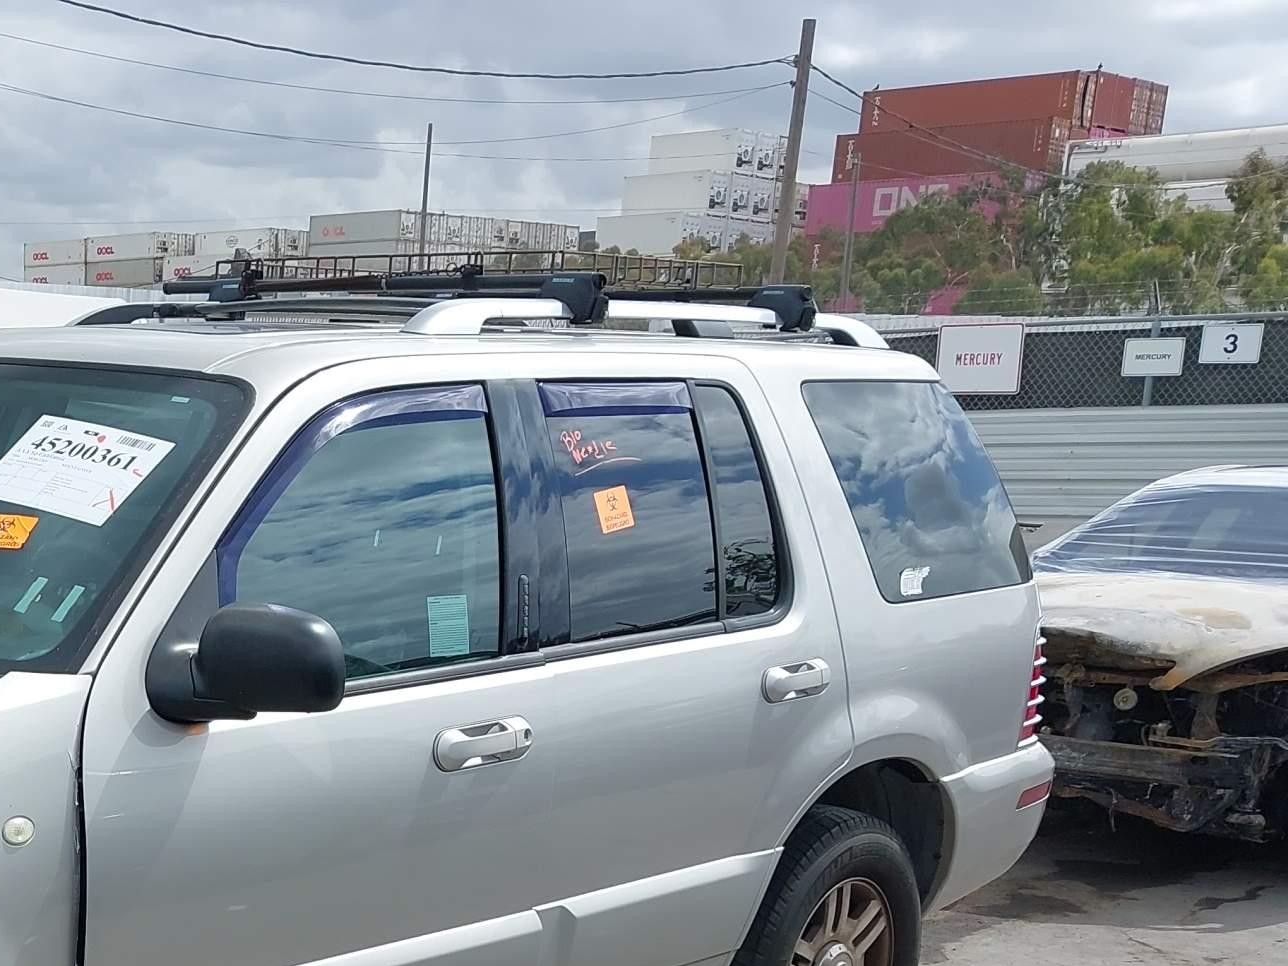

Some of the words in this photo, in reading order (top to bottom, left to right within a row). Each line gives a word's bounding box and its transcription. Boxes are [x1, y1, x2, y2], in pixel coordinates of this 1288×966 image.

[1222, 333, 1239, 355] 3
[955, 352, 1003, 366] MERCURY
[1134, 353, 1173, 362] MERCURY
[30, 435, 138, 472] 45200361
